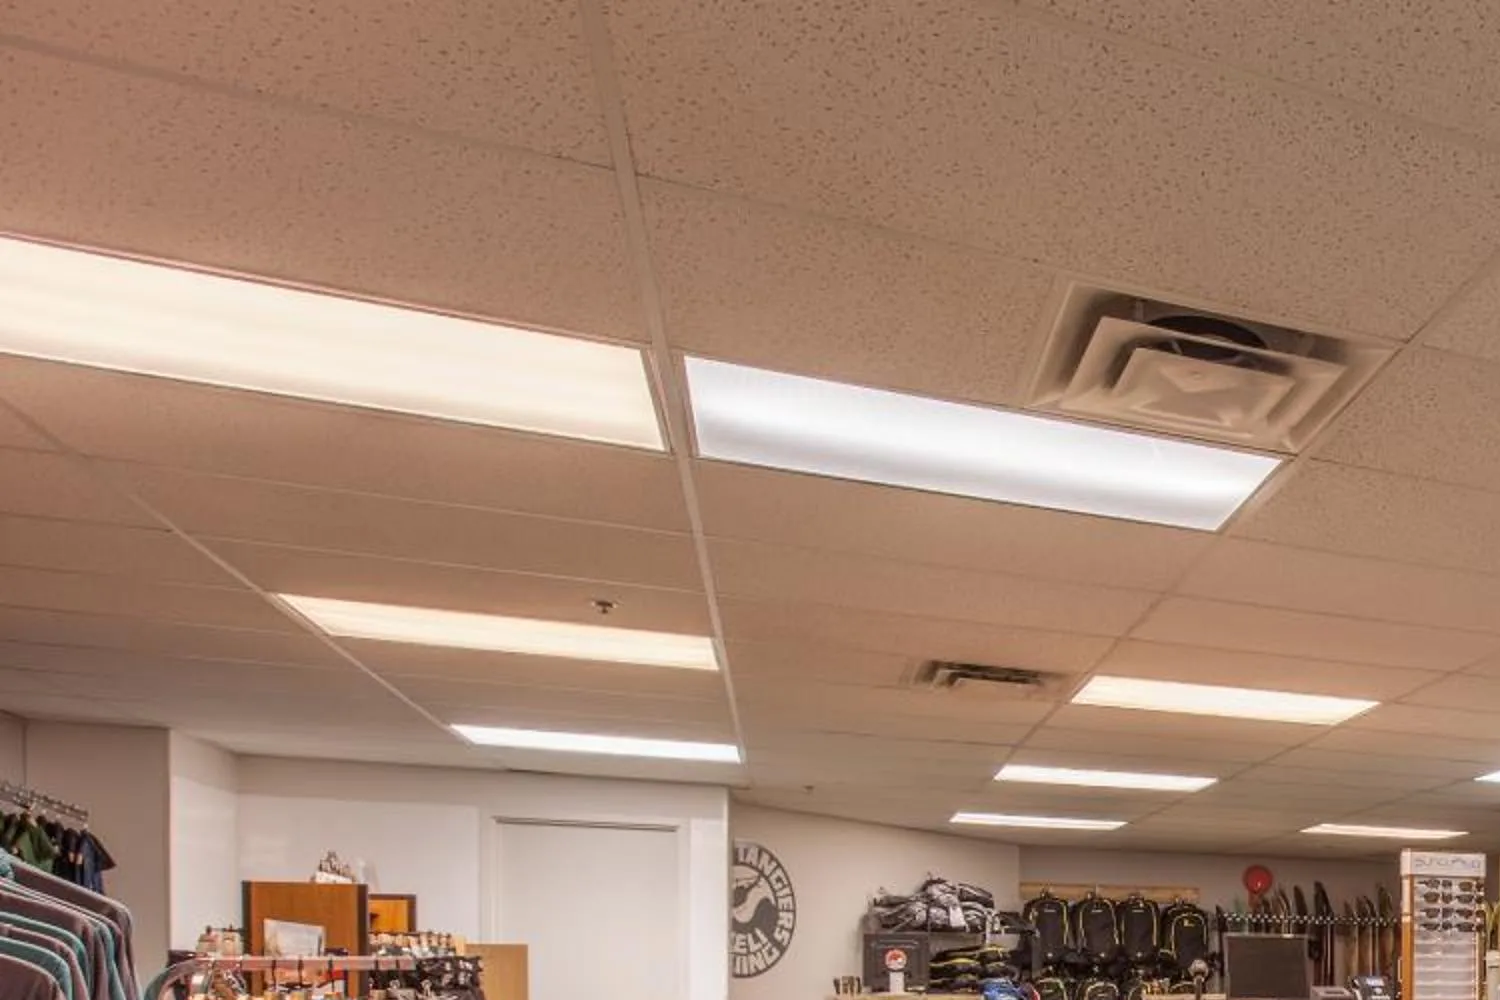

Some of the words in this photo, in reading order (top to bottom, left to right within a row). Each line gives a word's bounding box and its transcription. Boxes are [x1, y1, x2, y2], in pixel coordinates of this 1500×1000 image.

[737, 847, 794, 946] TANGIERS
[731, 928, 768, 953] ELI
[735, 942, 781, 975] IING
